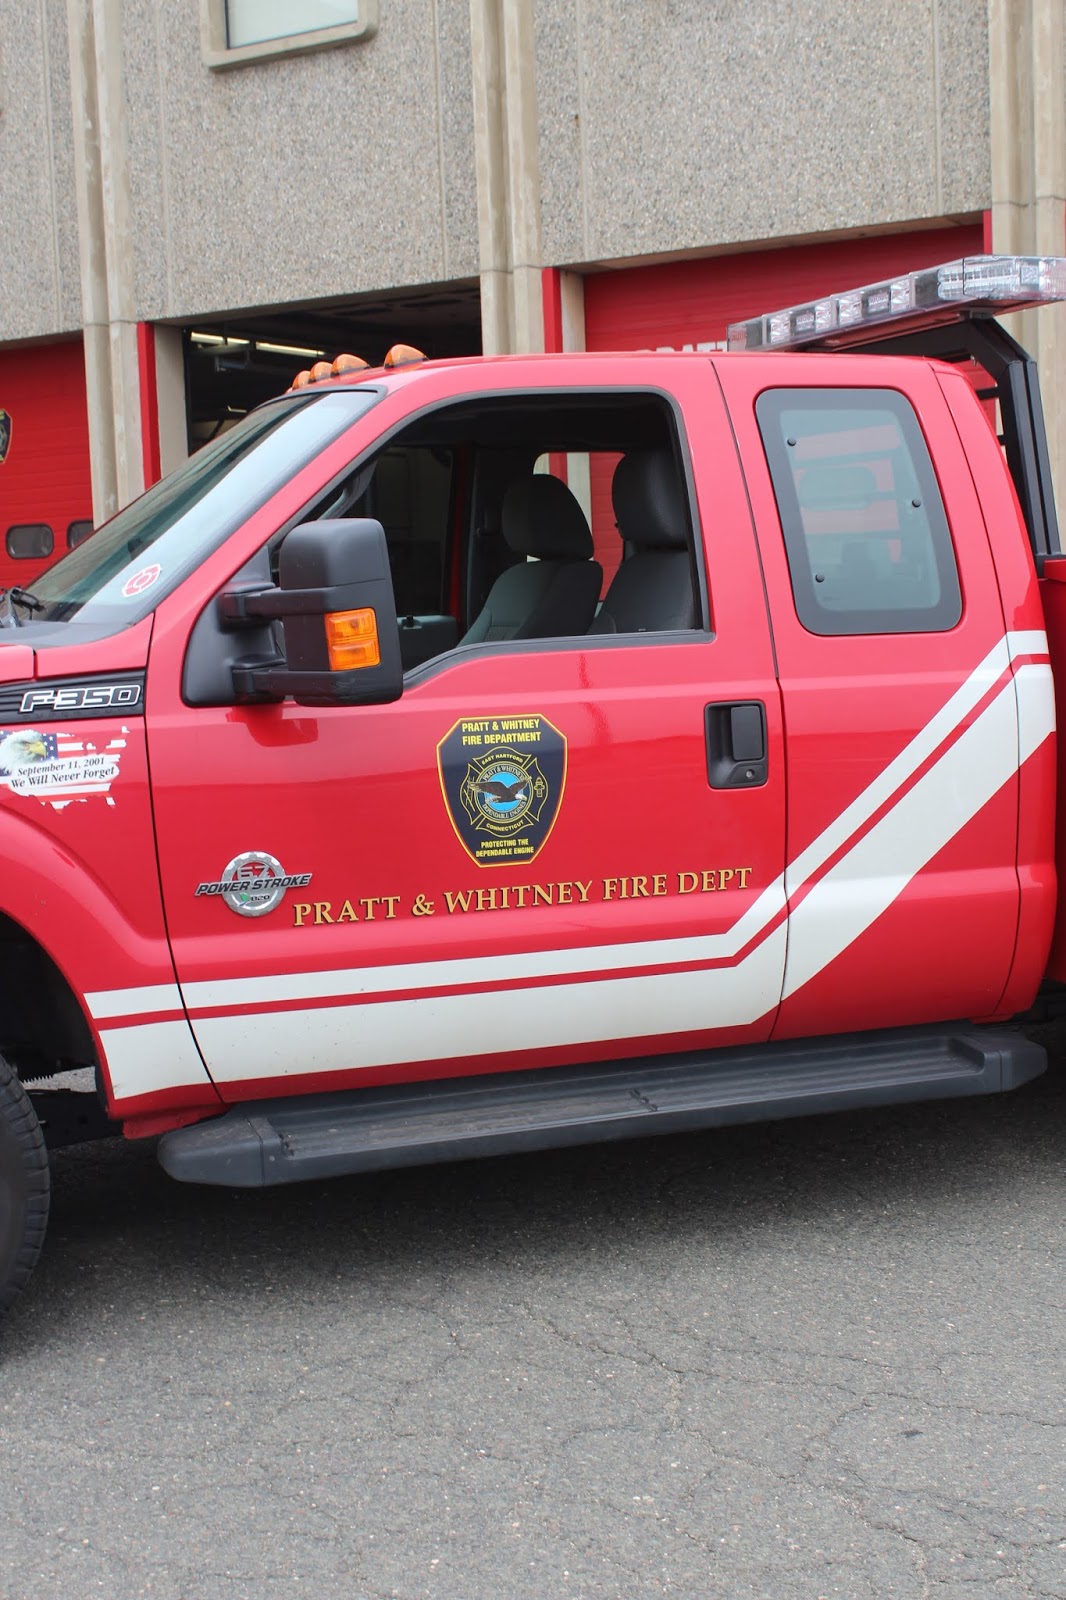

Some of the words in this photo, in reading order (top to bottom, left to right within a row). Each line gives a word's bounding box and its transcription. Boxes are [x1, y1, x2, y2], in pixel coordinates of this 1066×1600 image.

[20, 685, 141, 712] F-350
[462, 721, 489, 732] PRATT
[492, 720, 499, 731] &
[501, 719, 540, 730] WHITNEY
[462, 735, 482, 745] FIRE
[484, 732, 541, 744] DEPARTMENT
[481, 755, 495, 765] EAST
[496, 753, 524, 763] HARTFORD
[18, 764, 66, 777] September
[69, 760, 82, 770] 11,
[84, 757, 105, 768] 2001
[11, 778, 26, 788] We
[29, 774, 49, 786] Will
[51, 771, 81, 782] Never
[83, 766, 115, 780] Forget
[486, 820, 524, 831] CONNECTICUT
[481, 840, 517, 849] PROTECTING
[518, 838, 529, 846] THE
[475, 848, 513, 858] DEPENDABLE
[514, 846, 535, 855] ENGINE
[196, 881, 250, 895] POWER
[252, 874, 311, 890] STROKE
[293, 896, 400, 926] PRATT
[411, 893, 436, 917] &
[443, 880, 593, 914] WHITNEY
[602, 874, 669, 901] FIRE
[677, 867, 753, 894] DEPT
